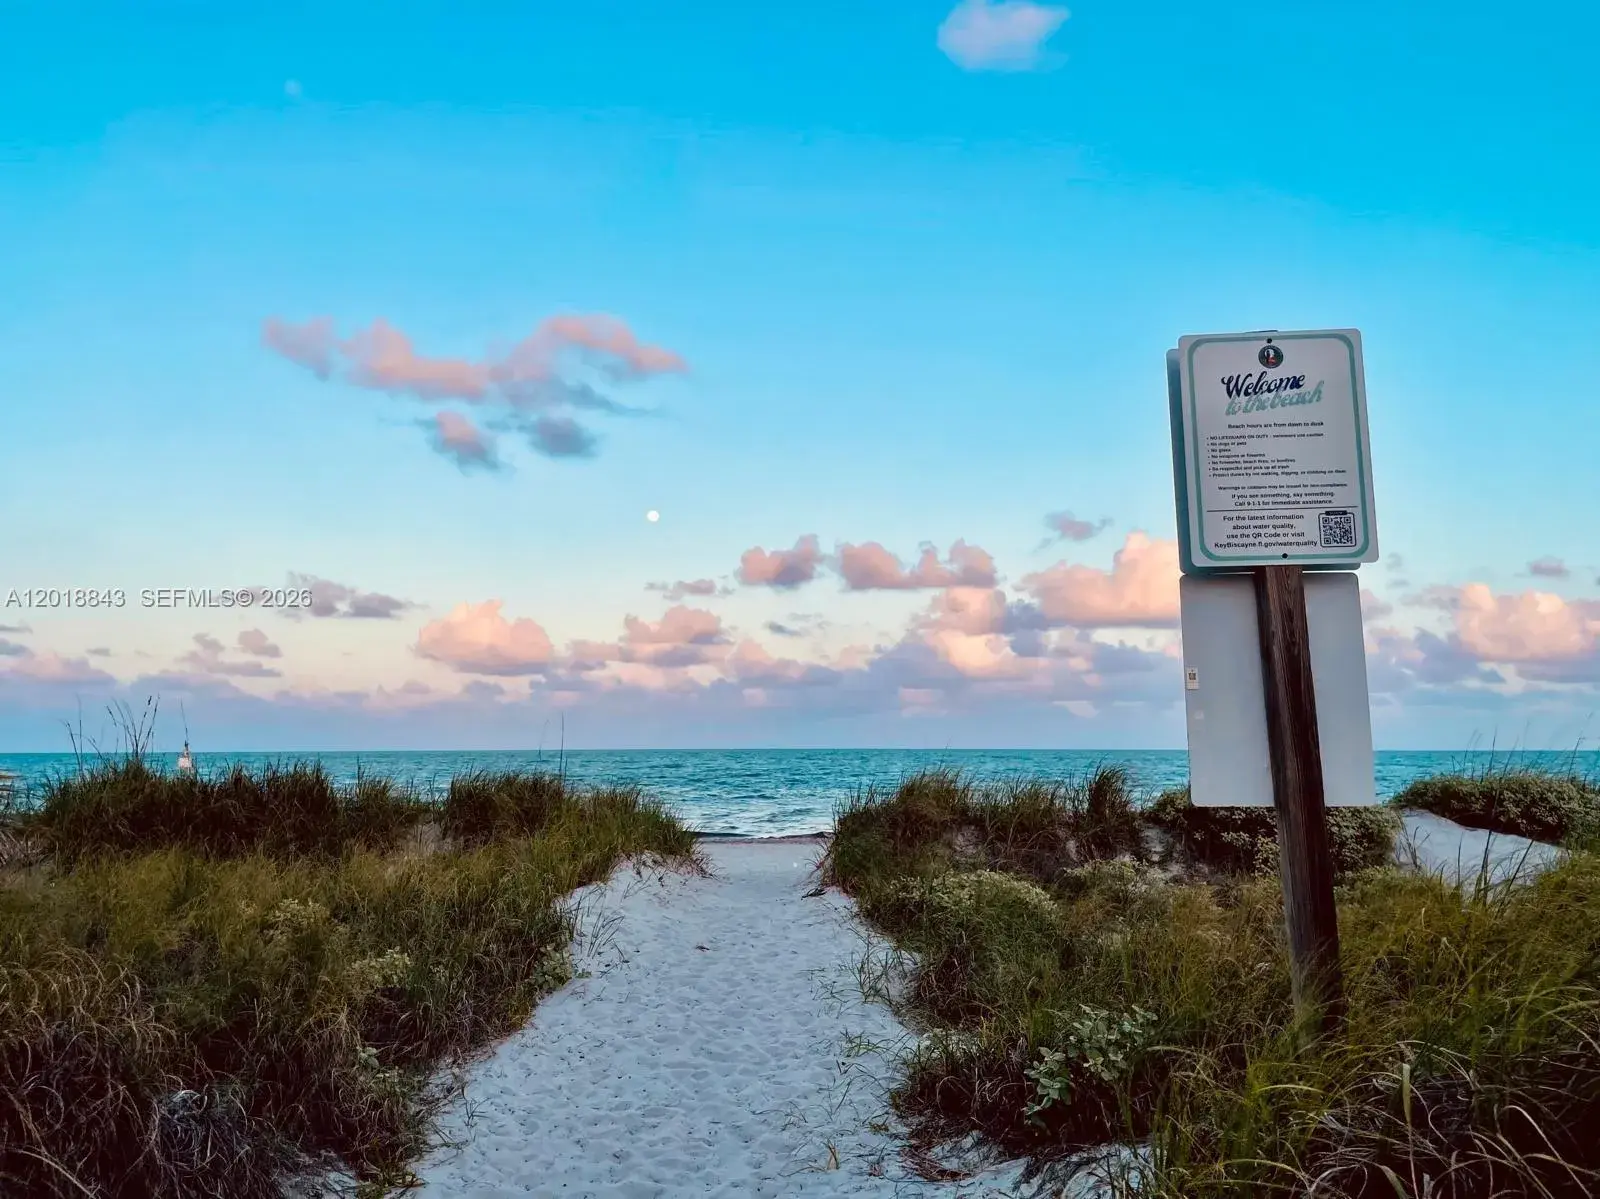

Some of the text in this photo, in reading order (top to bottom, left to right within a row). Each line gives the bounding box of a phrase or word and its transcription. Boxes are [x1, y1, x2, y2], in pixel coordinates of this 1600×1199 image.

[1221, 371, 1306, 399] Welcome
[1225, 396, 1241, 416] to
[1269, 379, 1325, 409] beach
[1247, 513, 1266, 521] latest
[1271, 522, 1296, 530] quality,
